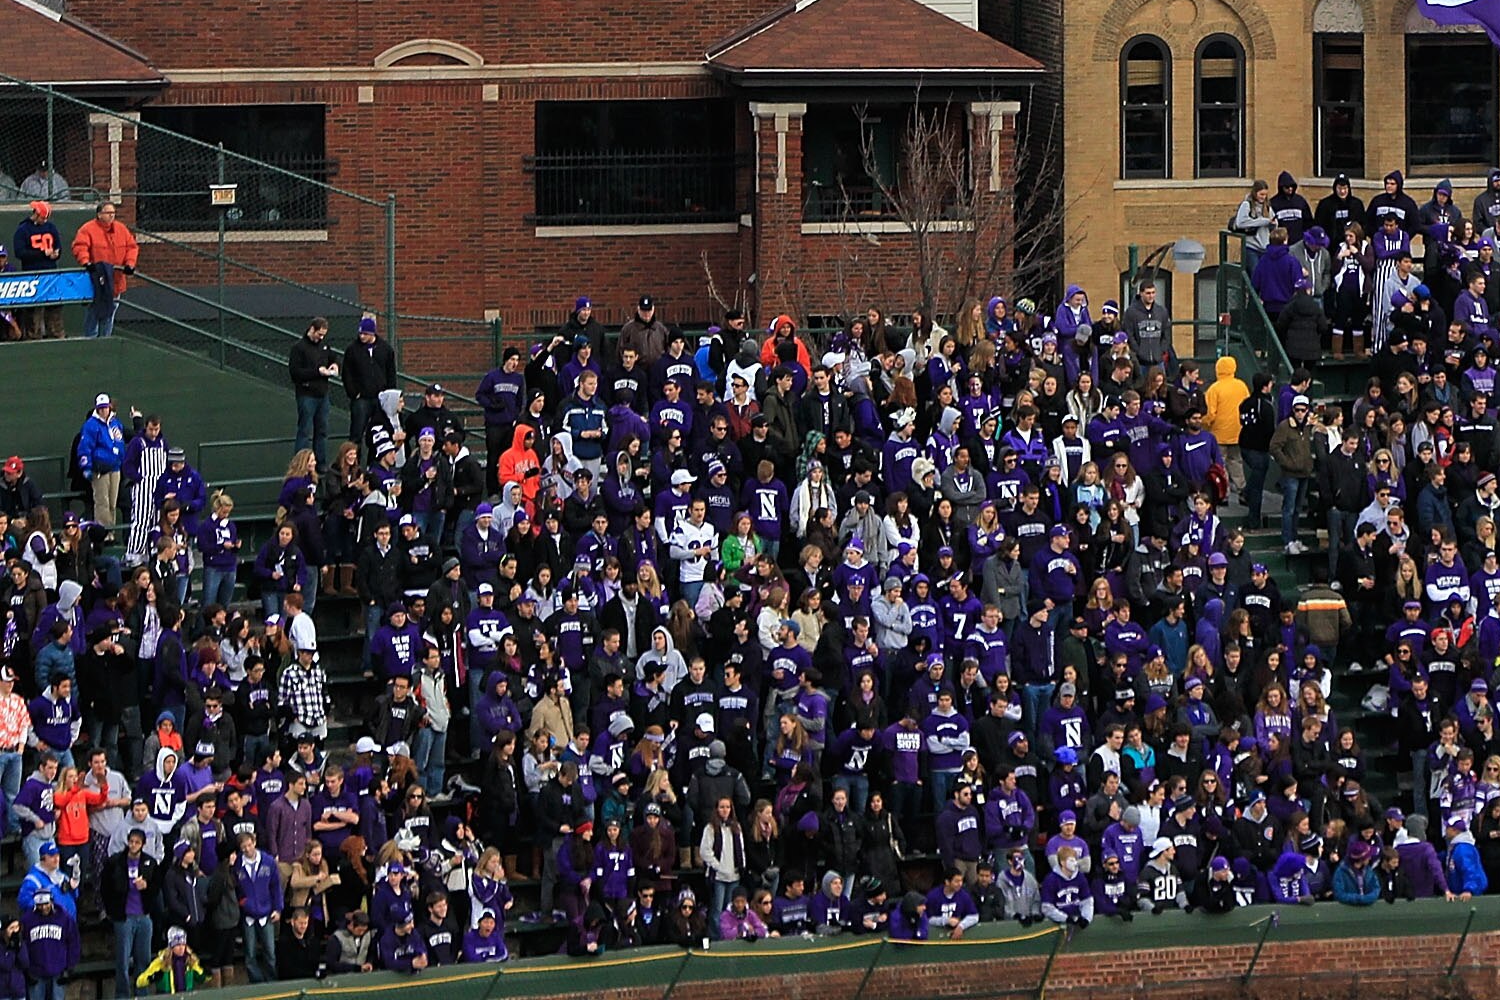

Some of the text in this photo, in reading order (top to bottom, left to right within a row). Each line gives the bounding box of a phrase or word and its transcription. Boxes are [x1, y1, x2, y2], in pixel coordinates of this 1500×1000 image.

[760, 492, 776, 519] N
[954, 613, 967, 640] 7
[1154, 876, 1177, 901] 20
